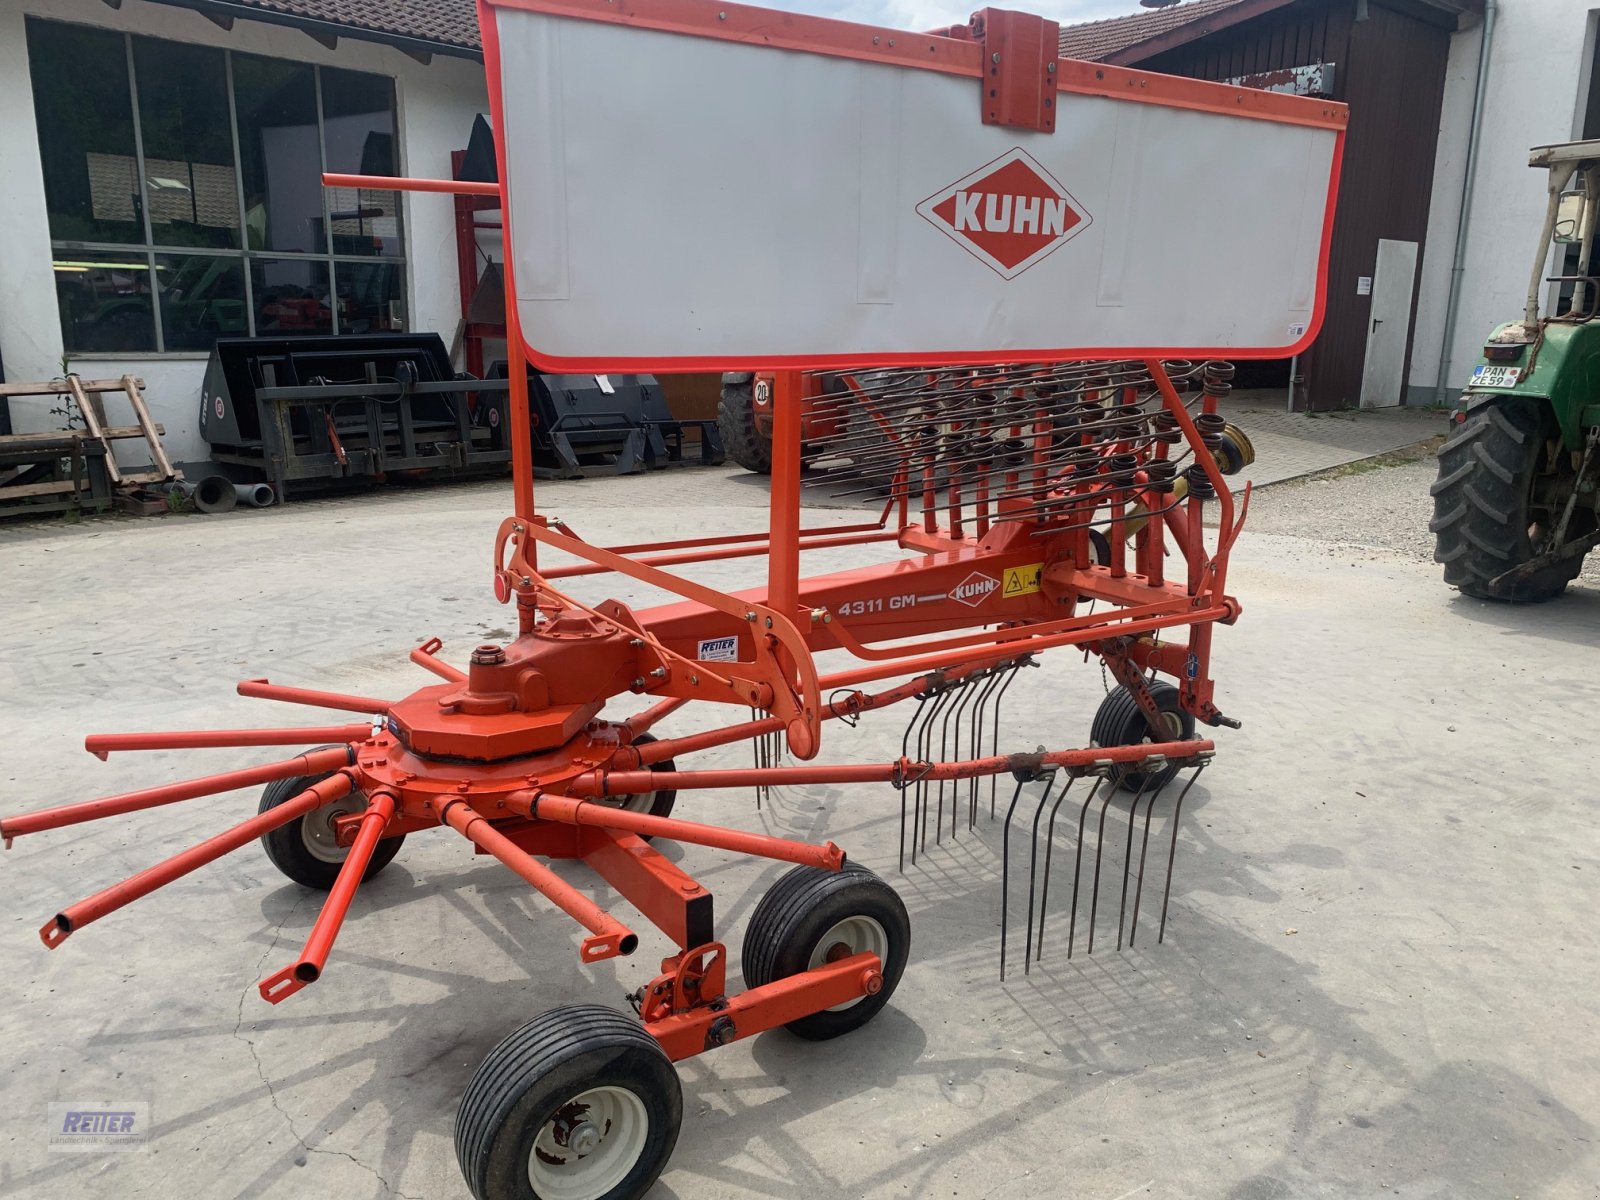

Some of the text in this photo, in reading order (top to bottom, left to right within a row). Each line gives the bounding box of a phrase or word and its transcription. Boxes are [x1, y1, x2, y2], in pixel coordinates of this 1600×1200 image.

[954, 190, 1067, 237] KUHN
[1482, 367, 1508, 377] PAN
[757, 384, 767, 402] 20
[955, 579, 994, 600] KUHN
[838, 594, 916, 616] 4311 GM
